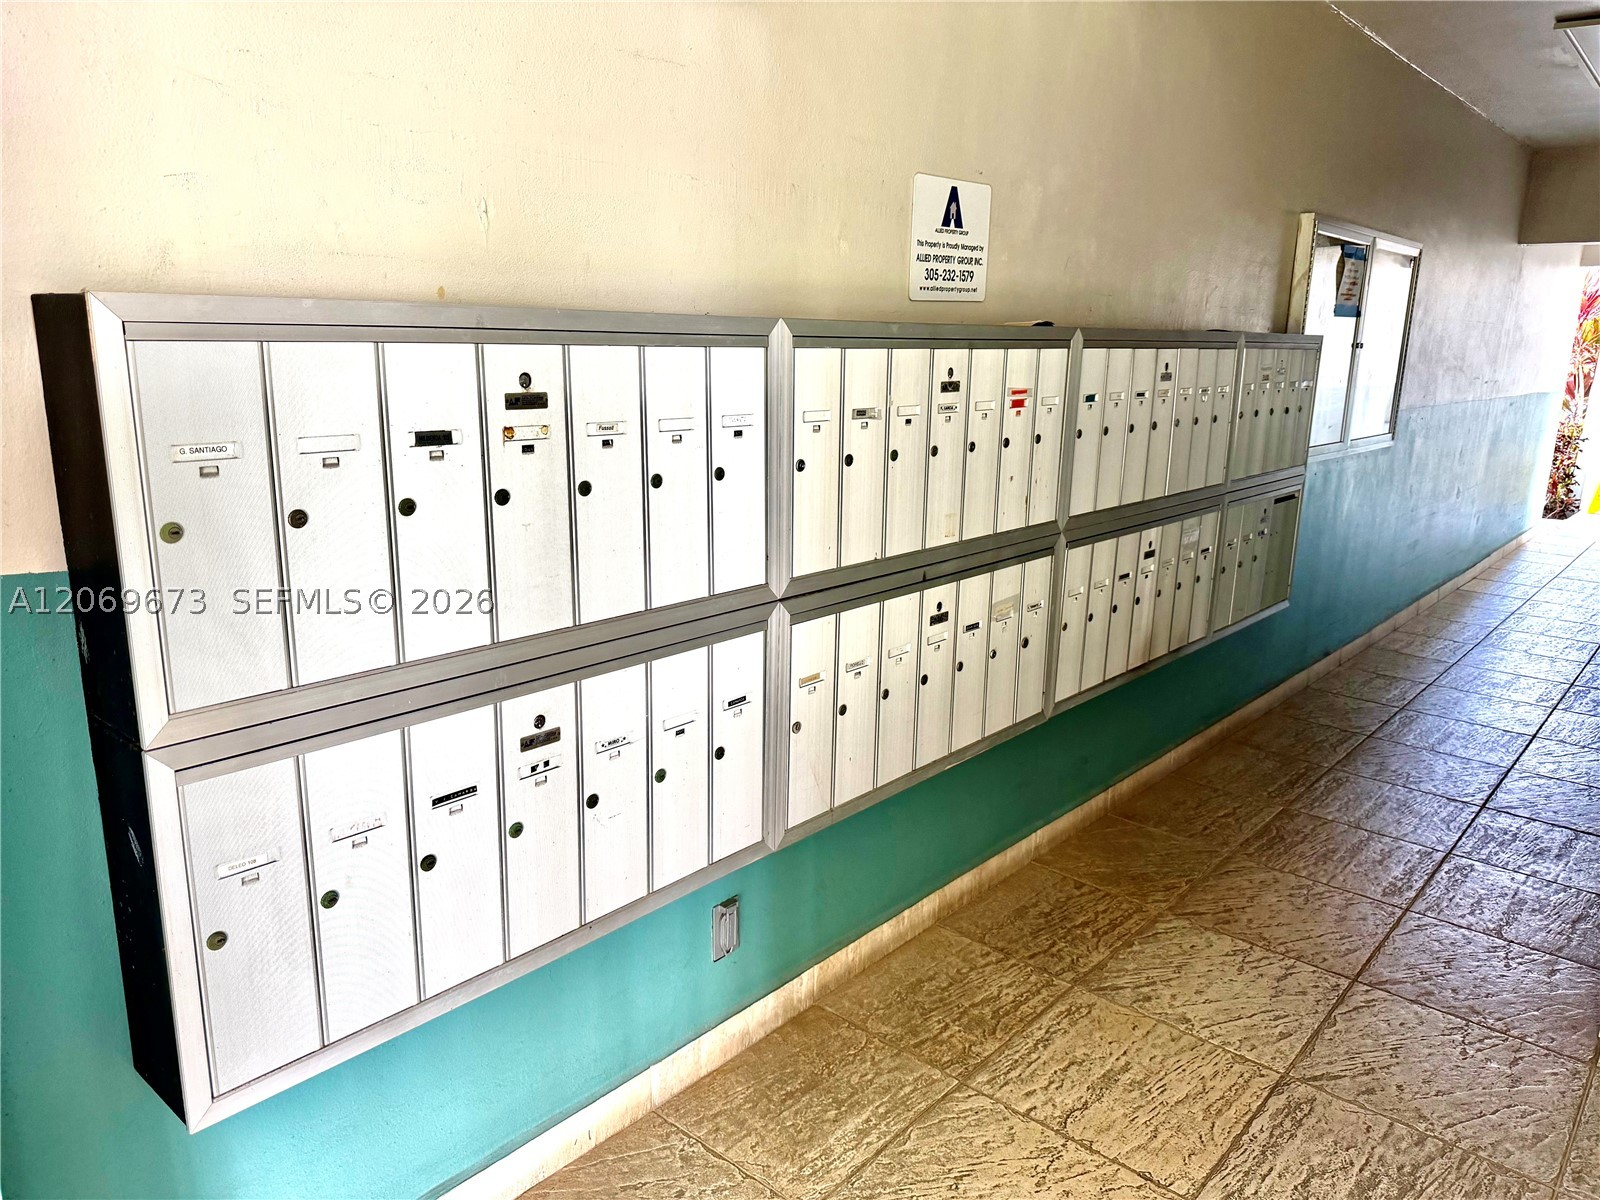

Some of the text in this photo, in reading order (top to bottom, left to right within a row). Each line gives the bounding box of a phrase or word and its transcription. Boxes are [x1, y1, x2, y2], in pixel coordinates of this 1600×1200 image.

[925, 240, 941, 249] Property
[946, 242, 960, 251] Proudly
[961, 243, 978, 252] Managed
[979, 245, 984, 253] by
[916, 253, 931, 262] ALLIED
[932, 254, 956, 264] PROPERTY
[974, 257, 983, 266] INC.
[924, 268, 974, 283] 305-232-1579
[179, 444, 228, 455] G. SANTIAGO
